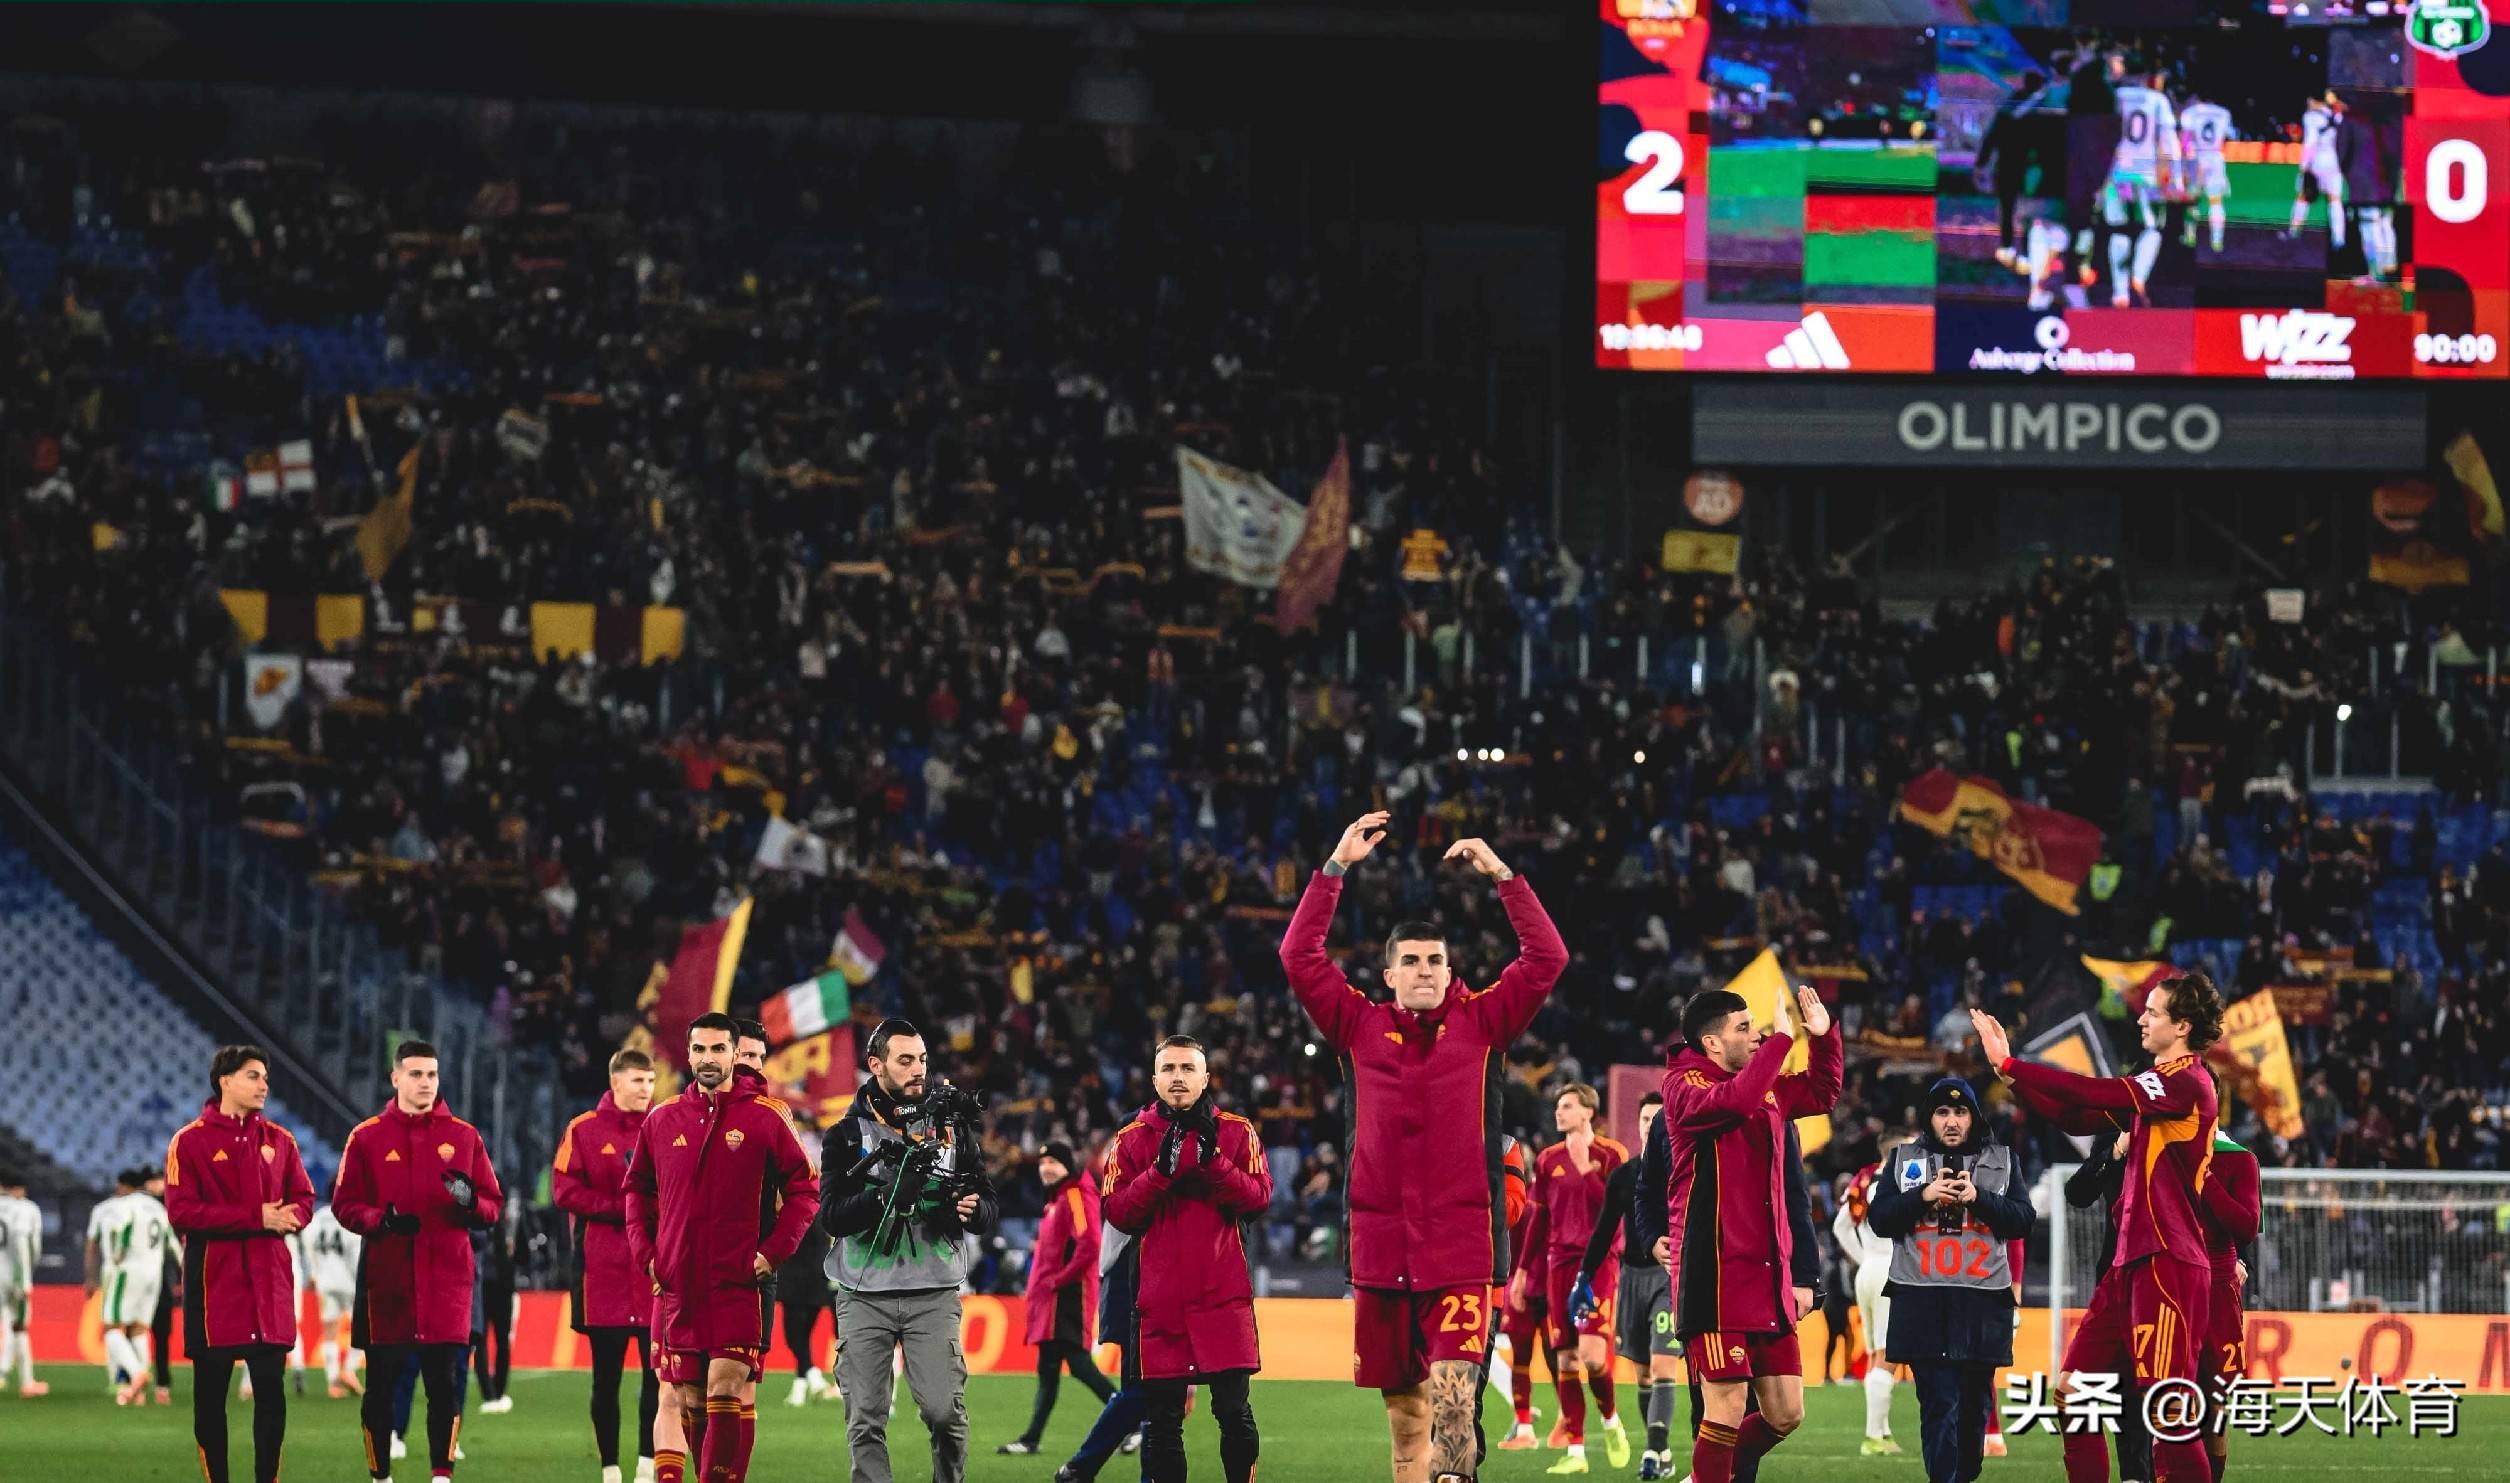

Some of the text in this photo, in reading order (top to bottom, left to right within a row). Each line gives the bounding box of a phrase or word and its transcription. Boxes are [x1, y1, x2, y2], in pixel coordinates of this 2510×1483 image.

[1622, 131, 1684, 214] 2
[2426, 139, 2487, 223] 0
[2043, 347, 2136, 371] Collection
[2414, 333, 2497, 362] 90:00
[1898, 403, 2221, 452] OLIMPICO
[1915, 1236, 1992, 1278] 102
[1440, 1294, 1482, 1333] 23
[2133, 1323, 2155, 1359] 7
